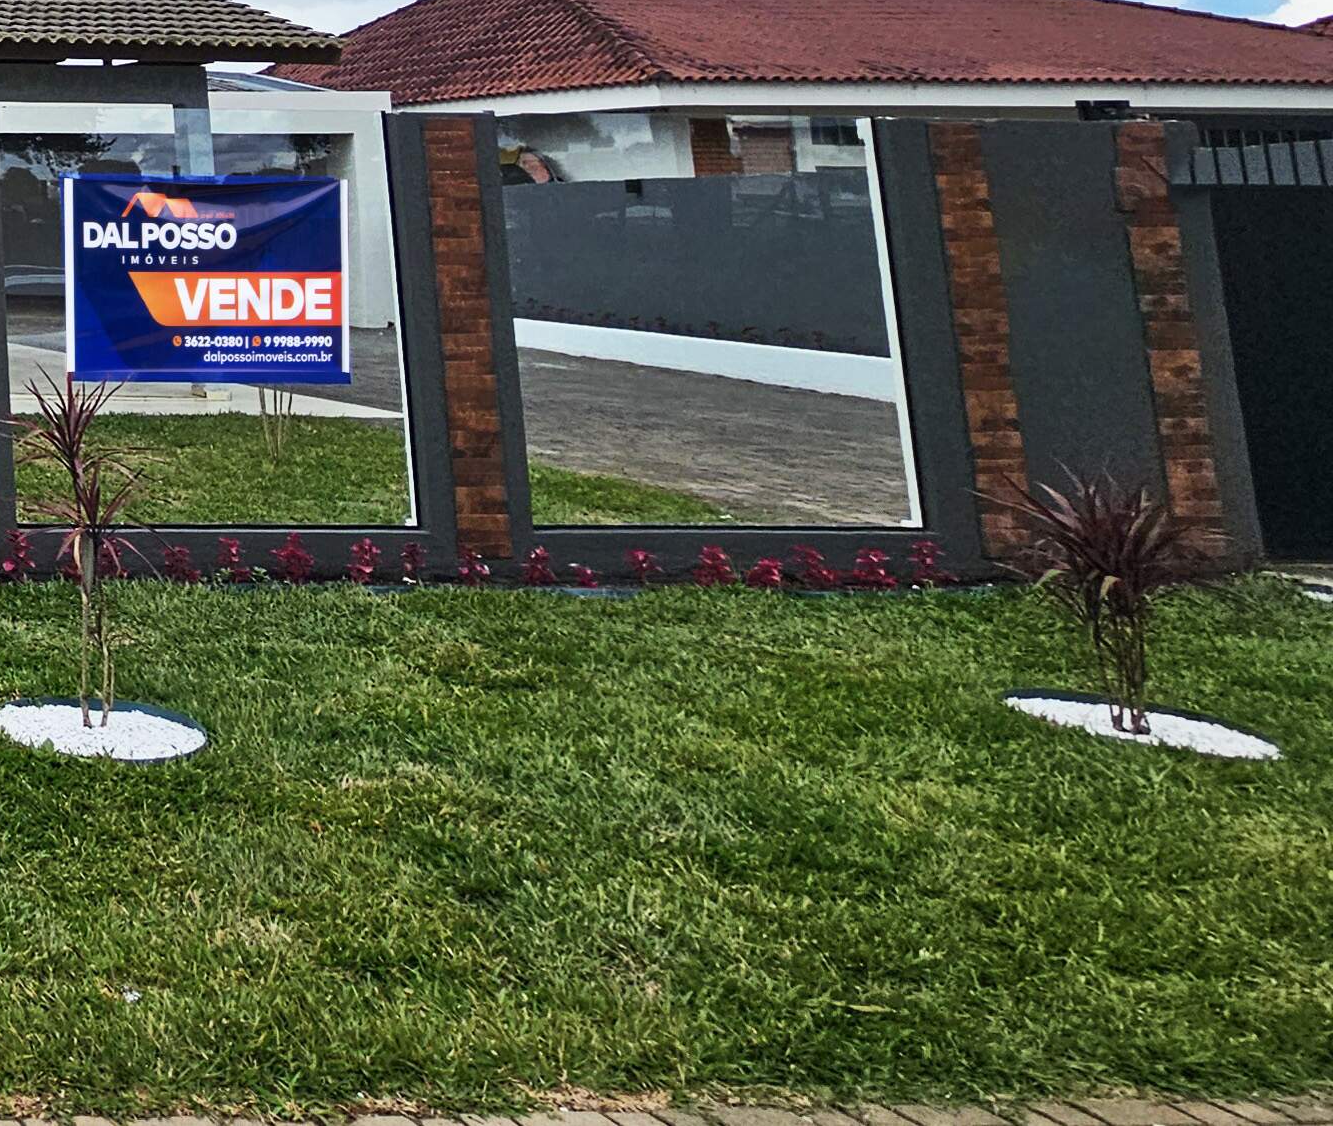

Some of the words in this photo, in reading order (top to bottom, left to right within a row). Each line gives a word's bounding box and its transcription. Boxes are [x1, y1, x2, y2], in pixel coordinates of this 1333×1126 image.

[83, 222, 139, 249] DAL
[141, 222, 237, 250] POSSO
[121, 252, 200, 265] IMÓVEIS
[173, 277, 333, 321] VENDE
[184, 335, 243, 348] 3622-0380
[263, 335, 272, 347] 9
[273, 335, 332, 348] 9988-9990
[203, 350, 333, 365] dalpossoimoveis.com.br
